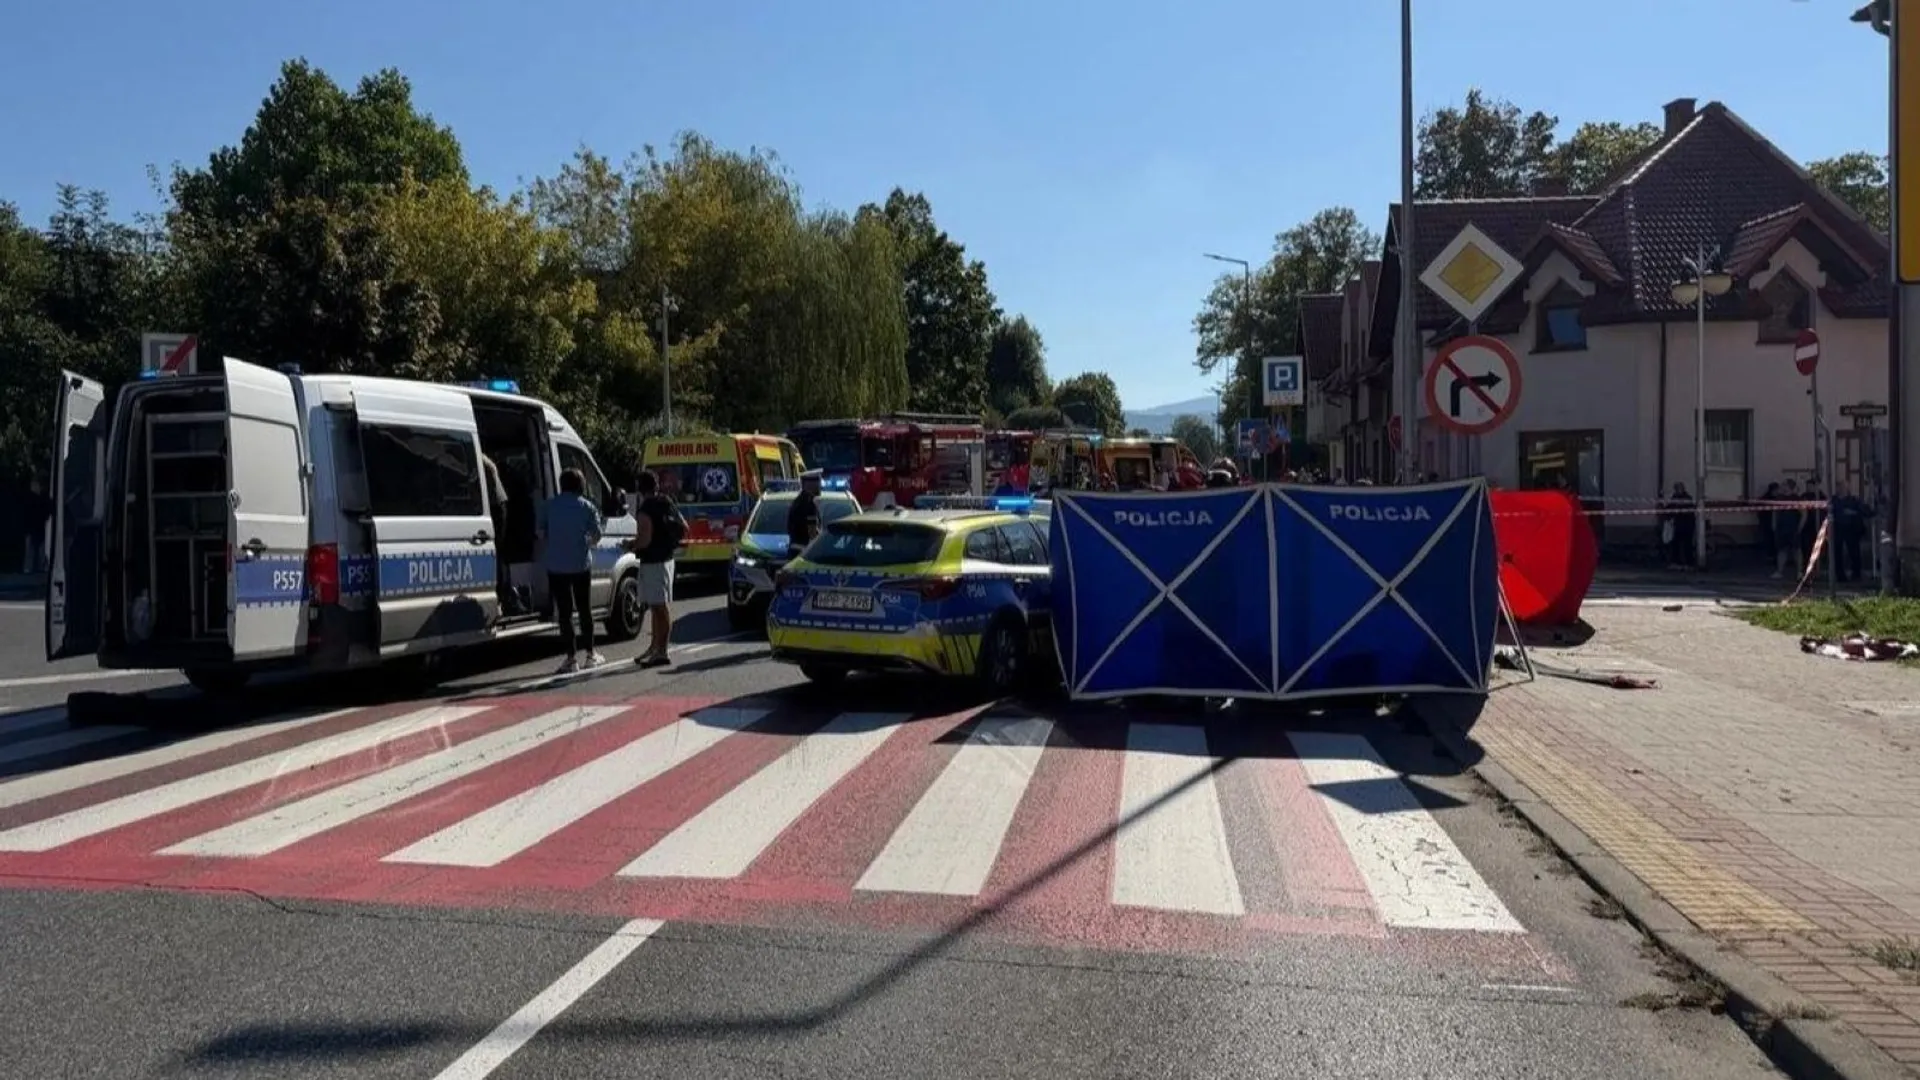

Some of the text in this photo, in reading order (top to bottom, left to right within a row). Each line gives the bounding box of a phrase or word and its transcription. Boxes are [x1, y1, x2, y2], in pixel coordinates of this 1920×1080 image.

[658, 442, 718, 457] AMBULANS
[1113, 510, 1213, 527] POLICJA
[1328, 504, 1431, 521] POLICJA
[409, 558, 473, 584] POLICJA
[273, 570, 302, 590] P557
